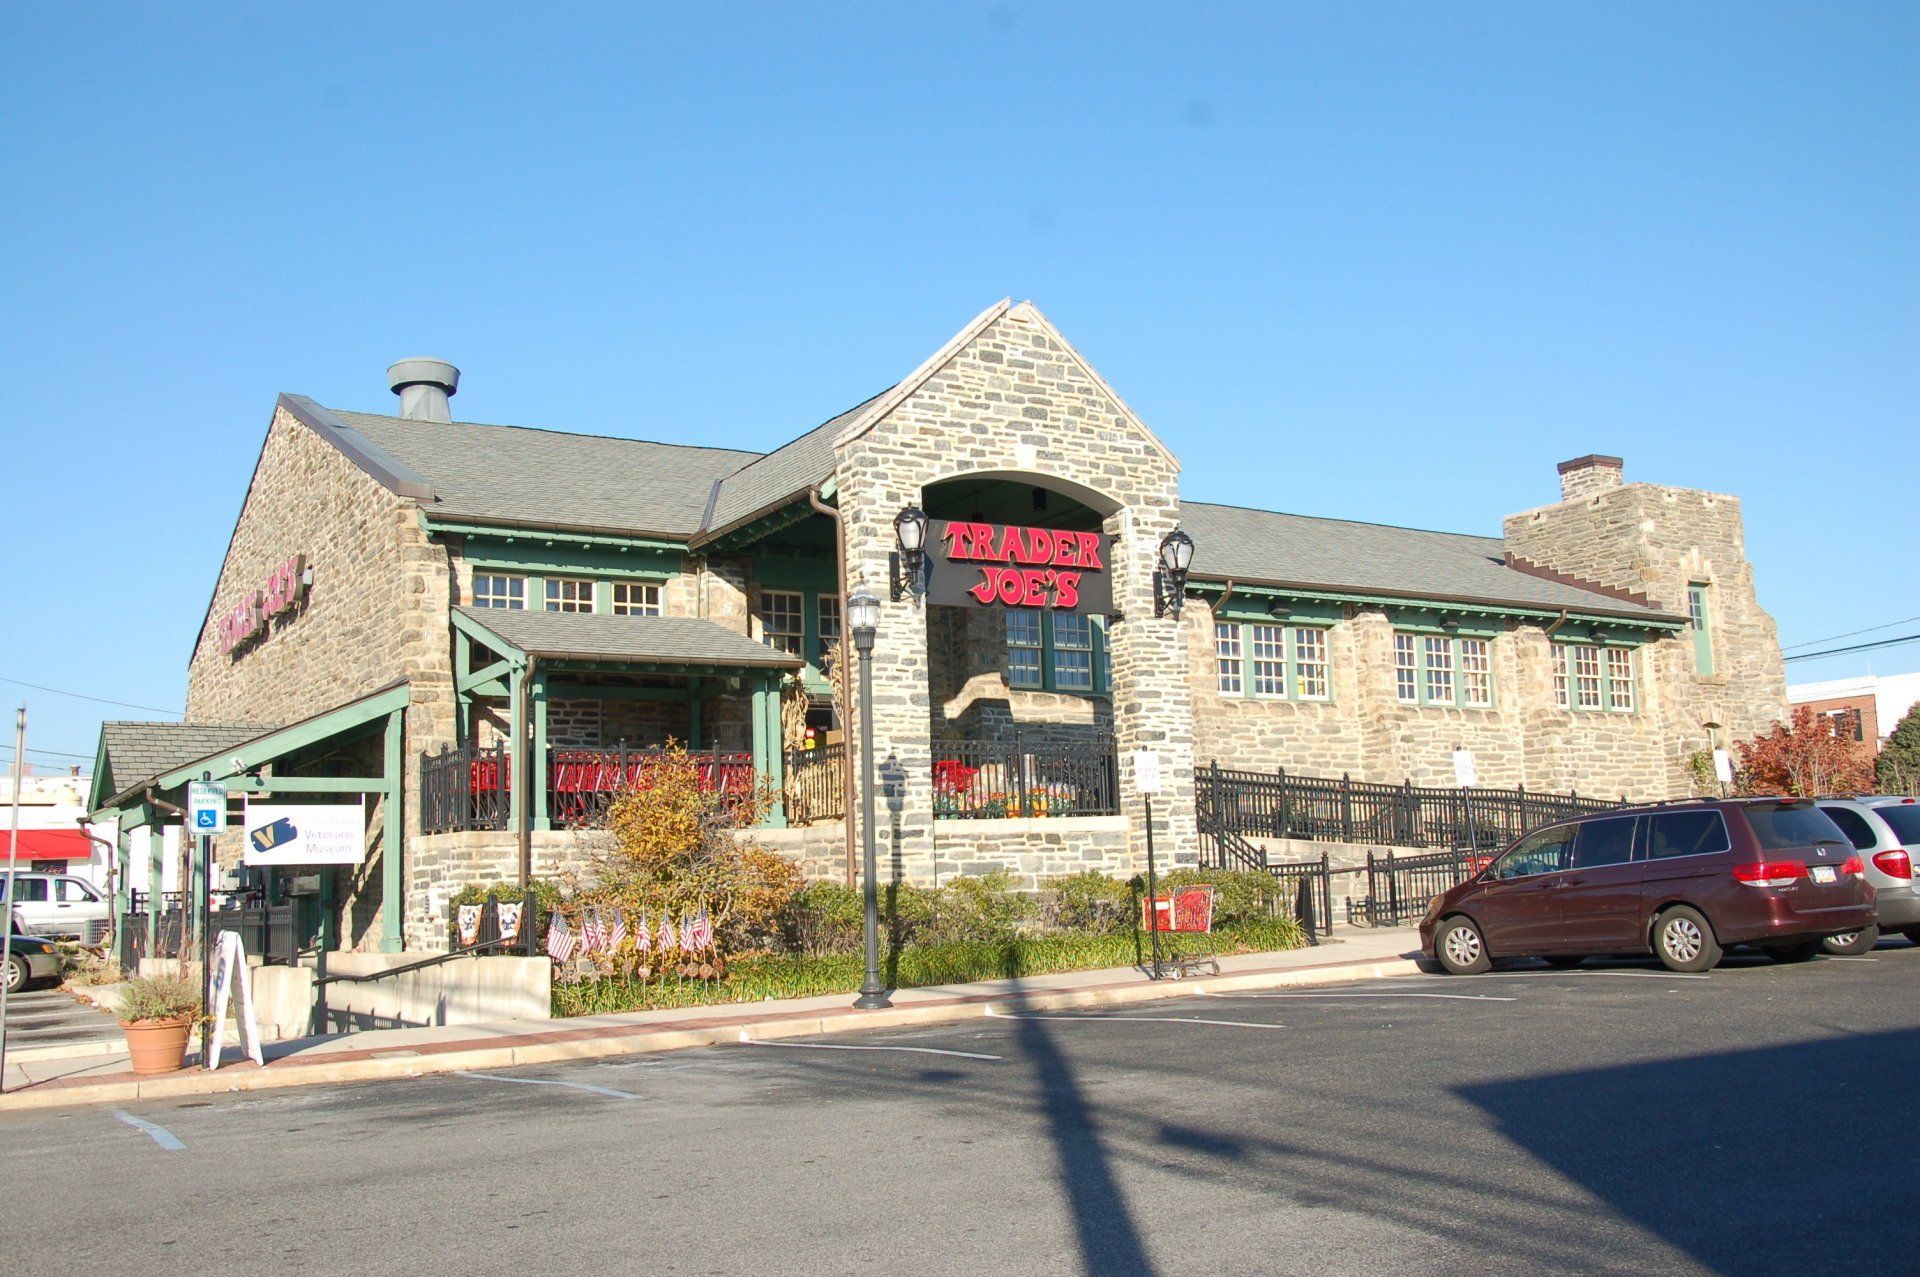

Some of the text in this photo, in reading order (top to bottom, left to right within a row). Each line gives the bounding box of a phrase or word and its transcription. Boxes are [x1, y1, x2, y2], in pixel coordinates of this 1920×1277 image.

[944, 521, 1104, 569] TRADER
[968, 566, 1082, 608] JOE'S
[191, 787, 224, 795] RESERVED
[193, 797, 222, 805] PARKING
[304, 829, 354, 839] Veterans
[305, 842, 352, 853] Museum
